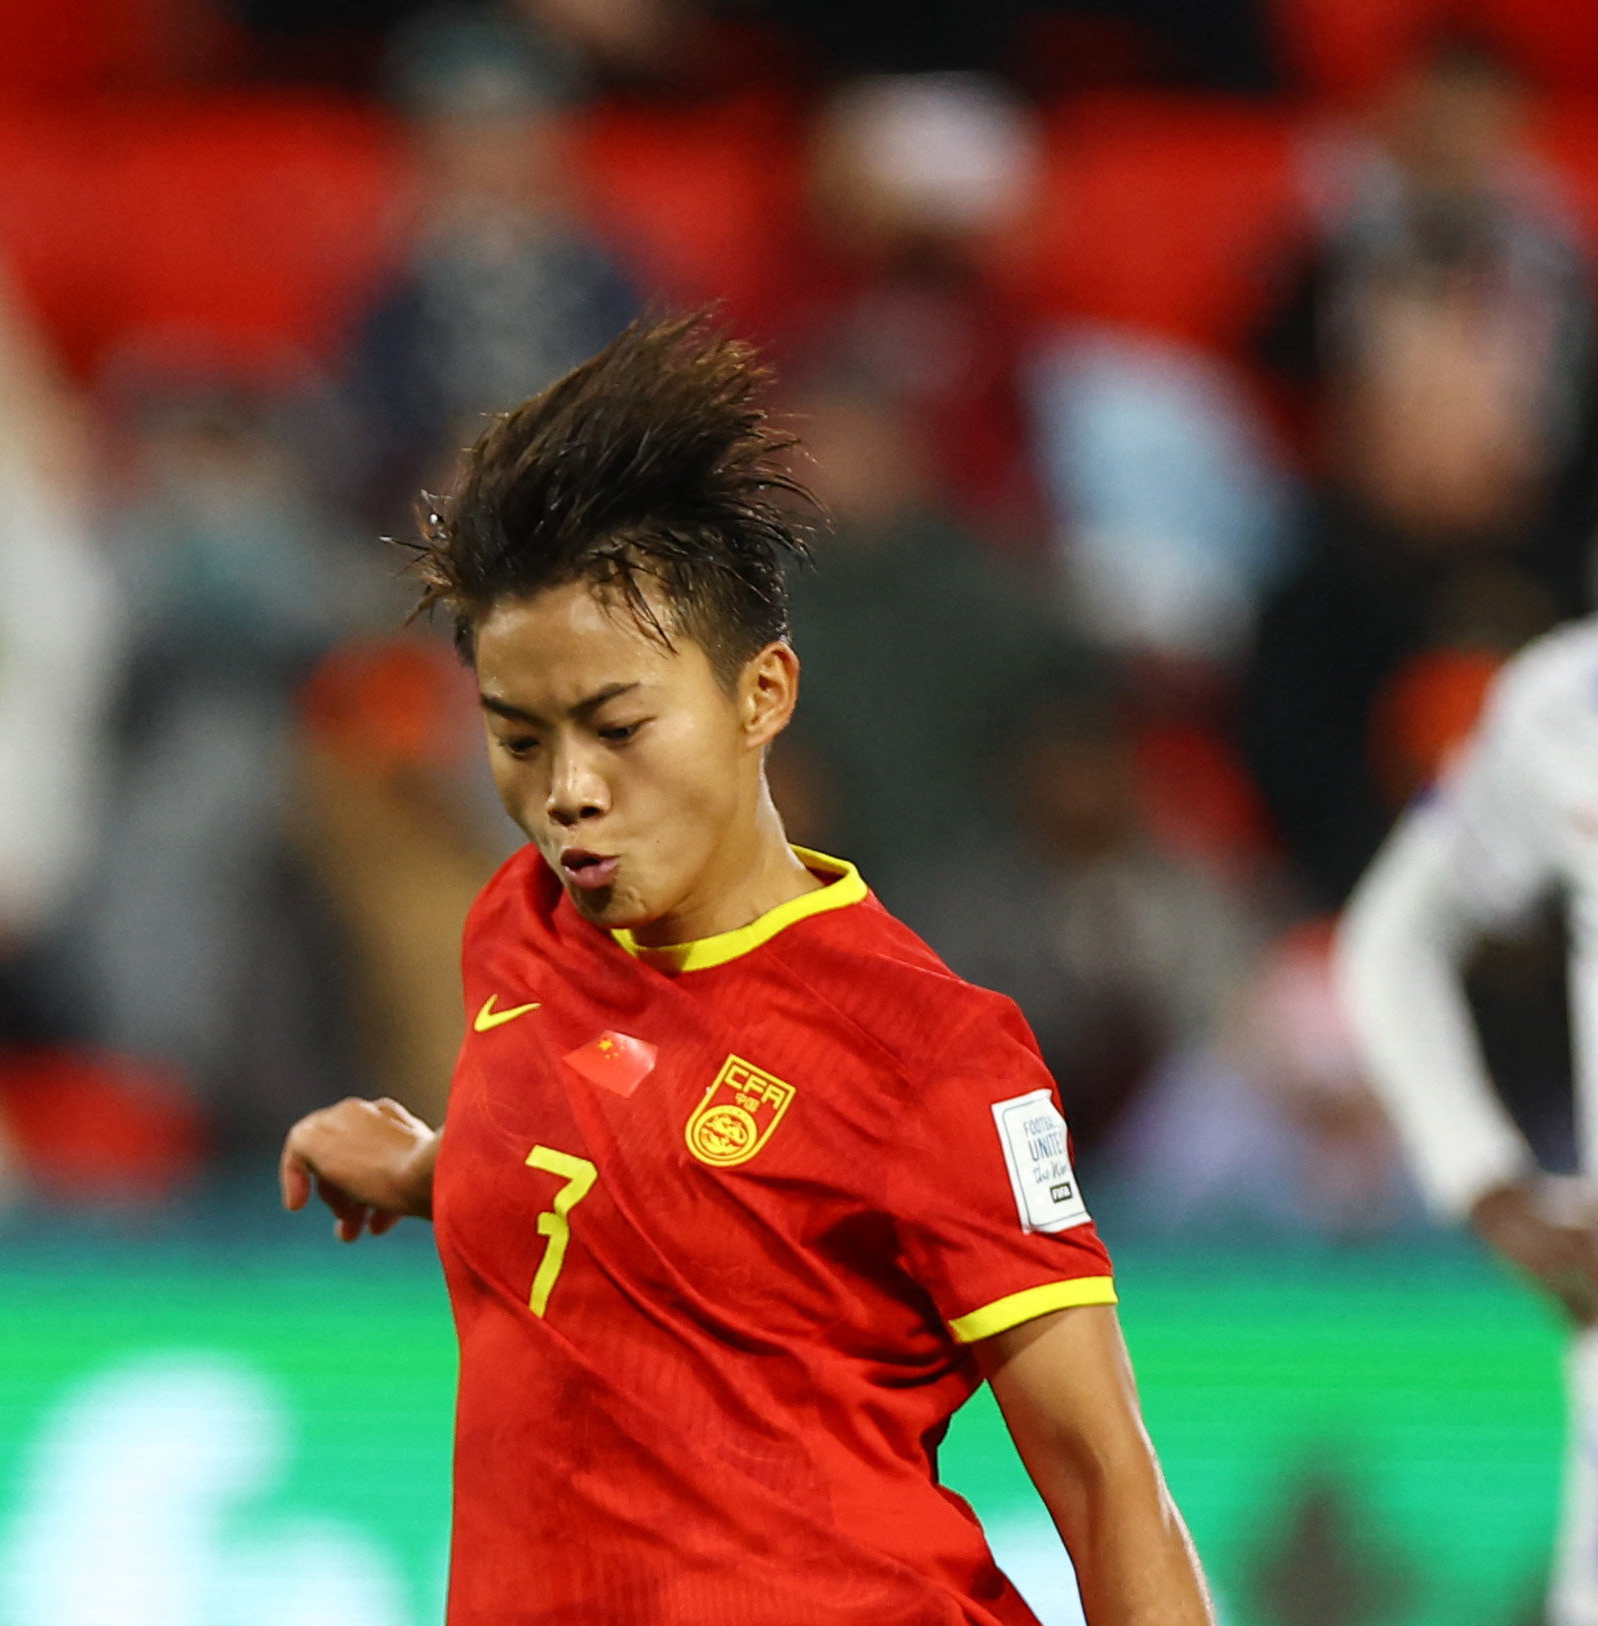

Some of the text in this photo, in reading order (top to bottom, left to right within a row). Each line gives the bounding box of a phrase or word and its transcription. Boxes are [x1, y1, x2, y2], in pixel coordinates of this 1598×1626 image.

[724, 1064, 787, 1110] CFA
[1022, 1115, 1062, 1138] FOOTB
[1028, 1130, 1064, 1162] UNITE
[525, 1144, 599, 1318] 7
